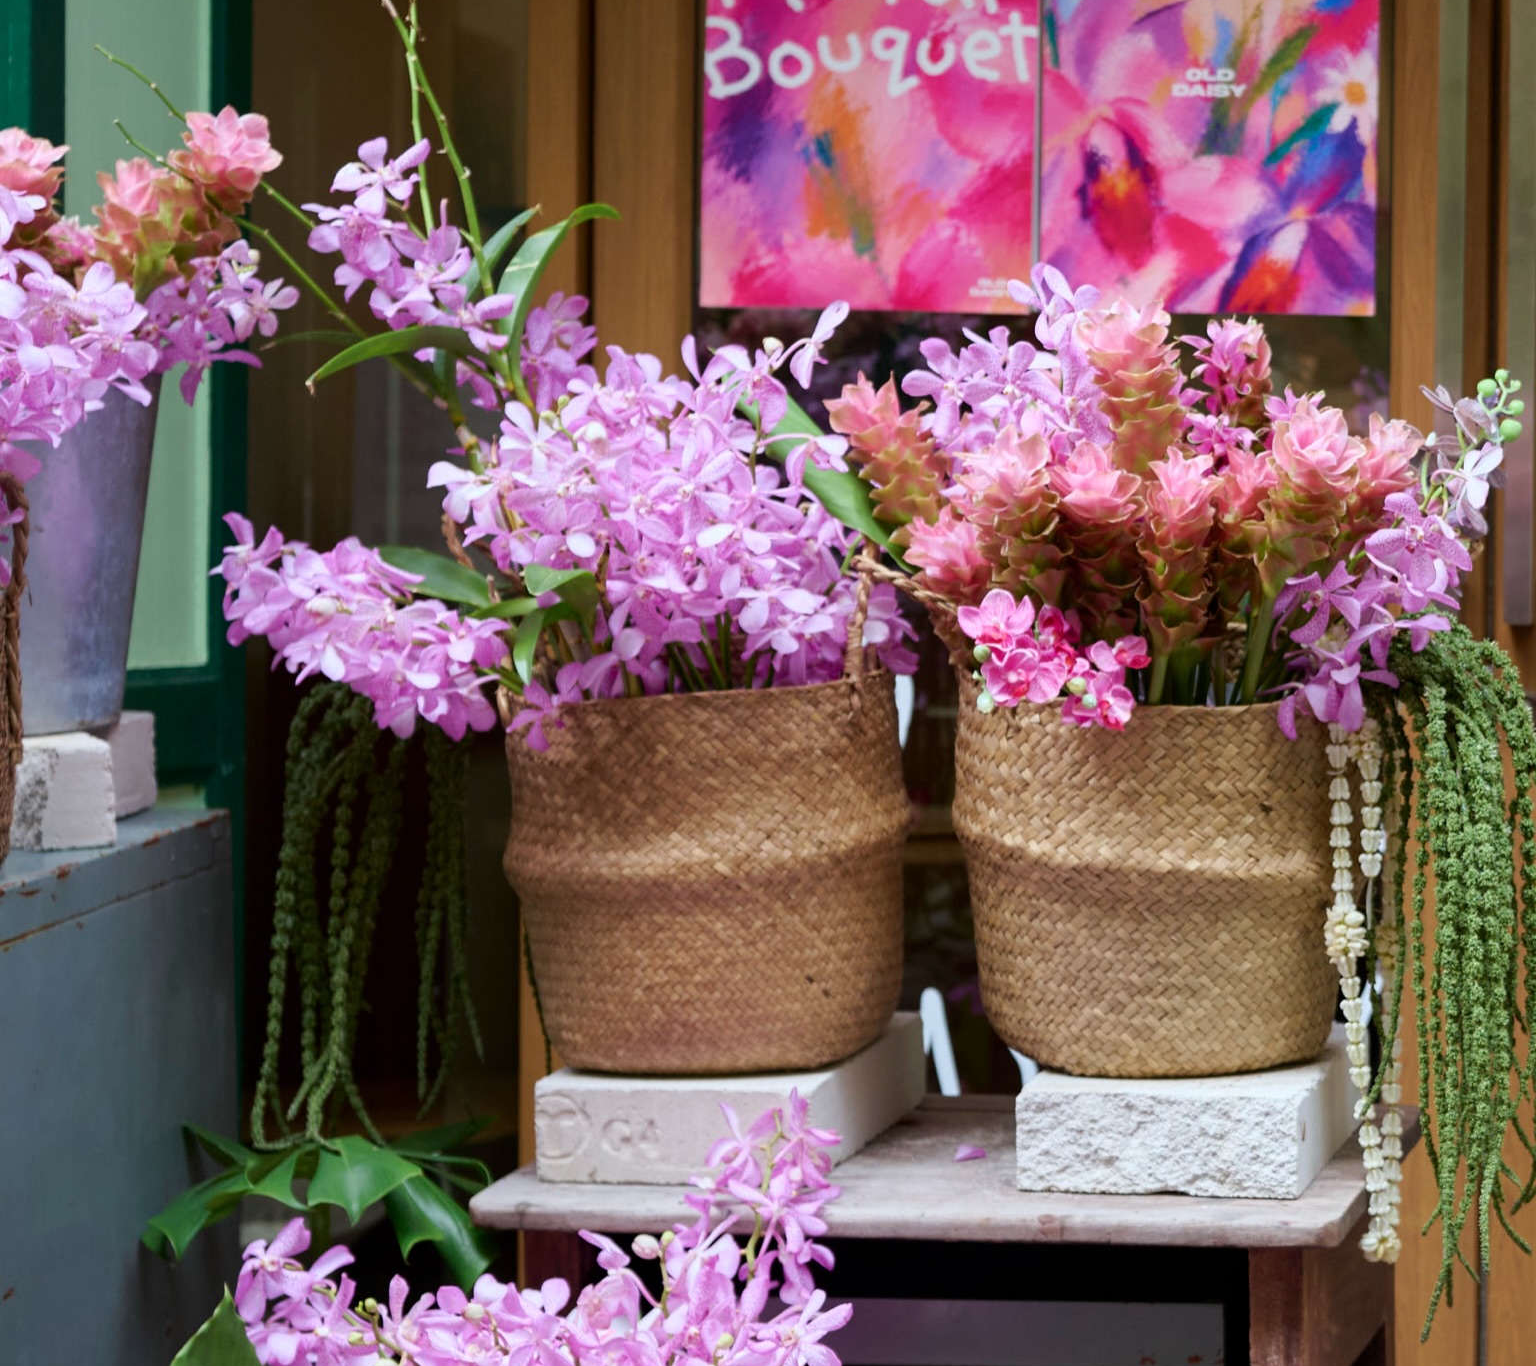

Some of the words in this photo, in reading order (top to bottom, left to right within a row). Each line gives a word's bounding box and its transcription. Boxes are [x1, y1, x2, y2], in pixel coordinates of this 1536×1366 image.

[704, 11, 1039, 99] Bouquet
[1185, 67, 1236, 82] OLD
[1171, 83, 1247, 98] DAISY
